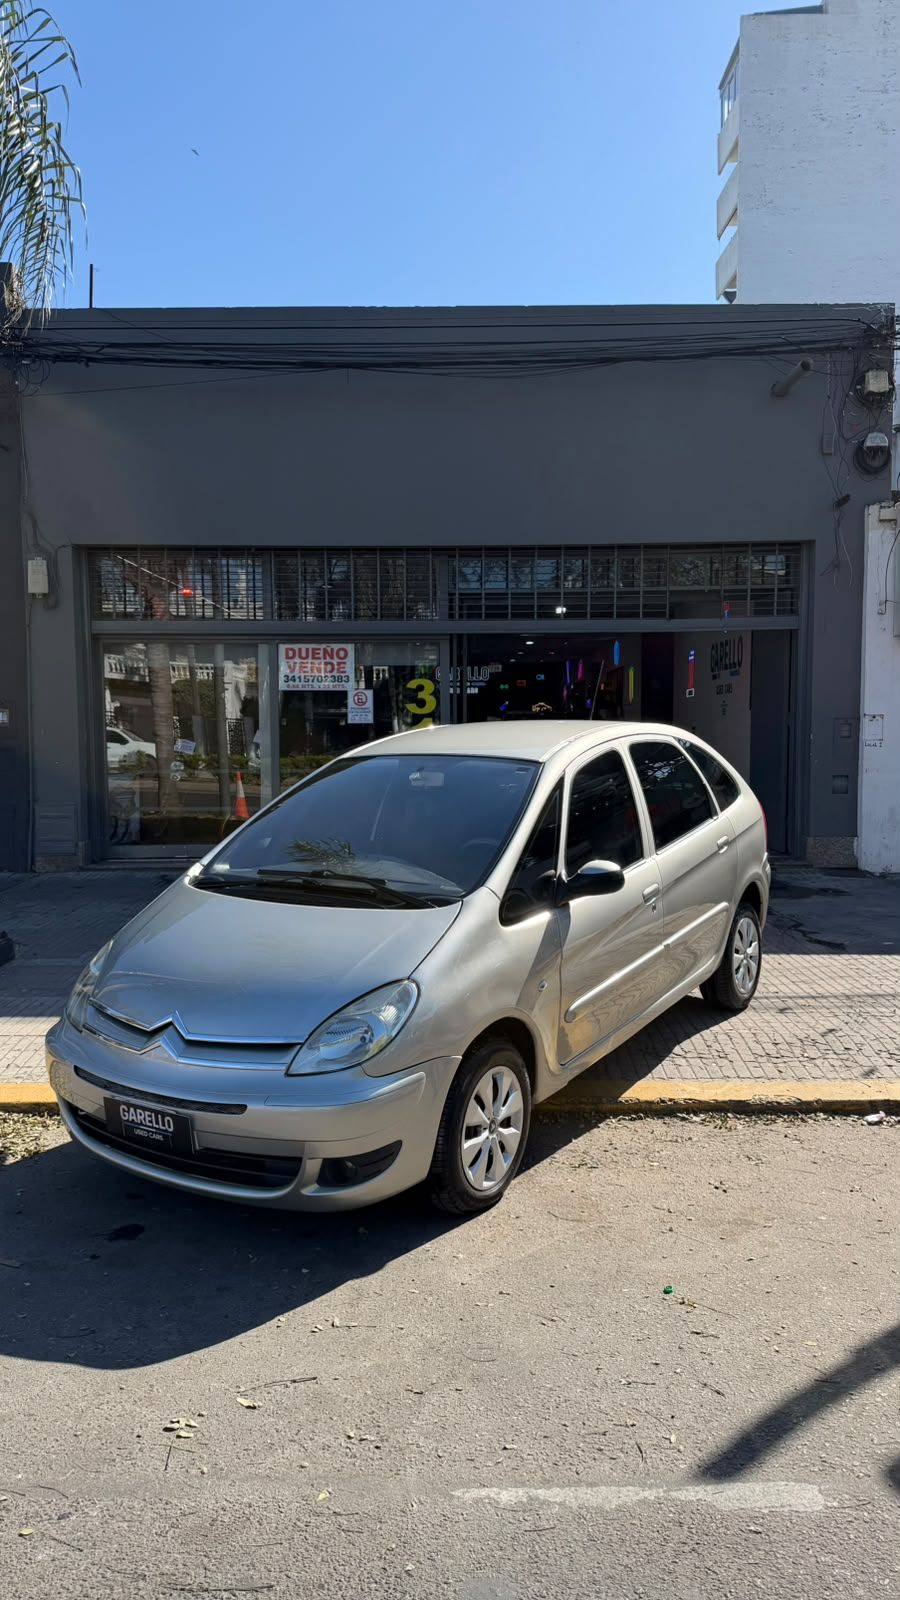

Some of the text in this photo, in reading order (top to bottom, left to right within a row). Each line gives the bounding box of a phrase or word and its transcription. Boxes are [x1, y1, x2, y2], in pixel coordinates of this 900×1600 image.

[285, 645, 349, 660] DUEÑO
[711, 636, 743, 673] GARELLO
[286, 661, 347, 674] VENDE
[283, 675, 350, 683] 3415702383
[120, 1105, 174, 1132] GARELLO
[133, 1128, 164, 1141] USED CARS
